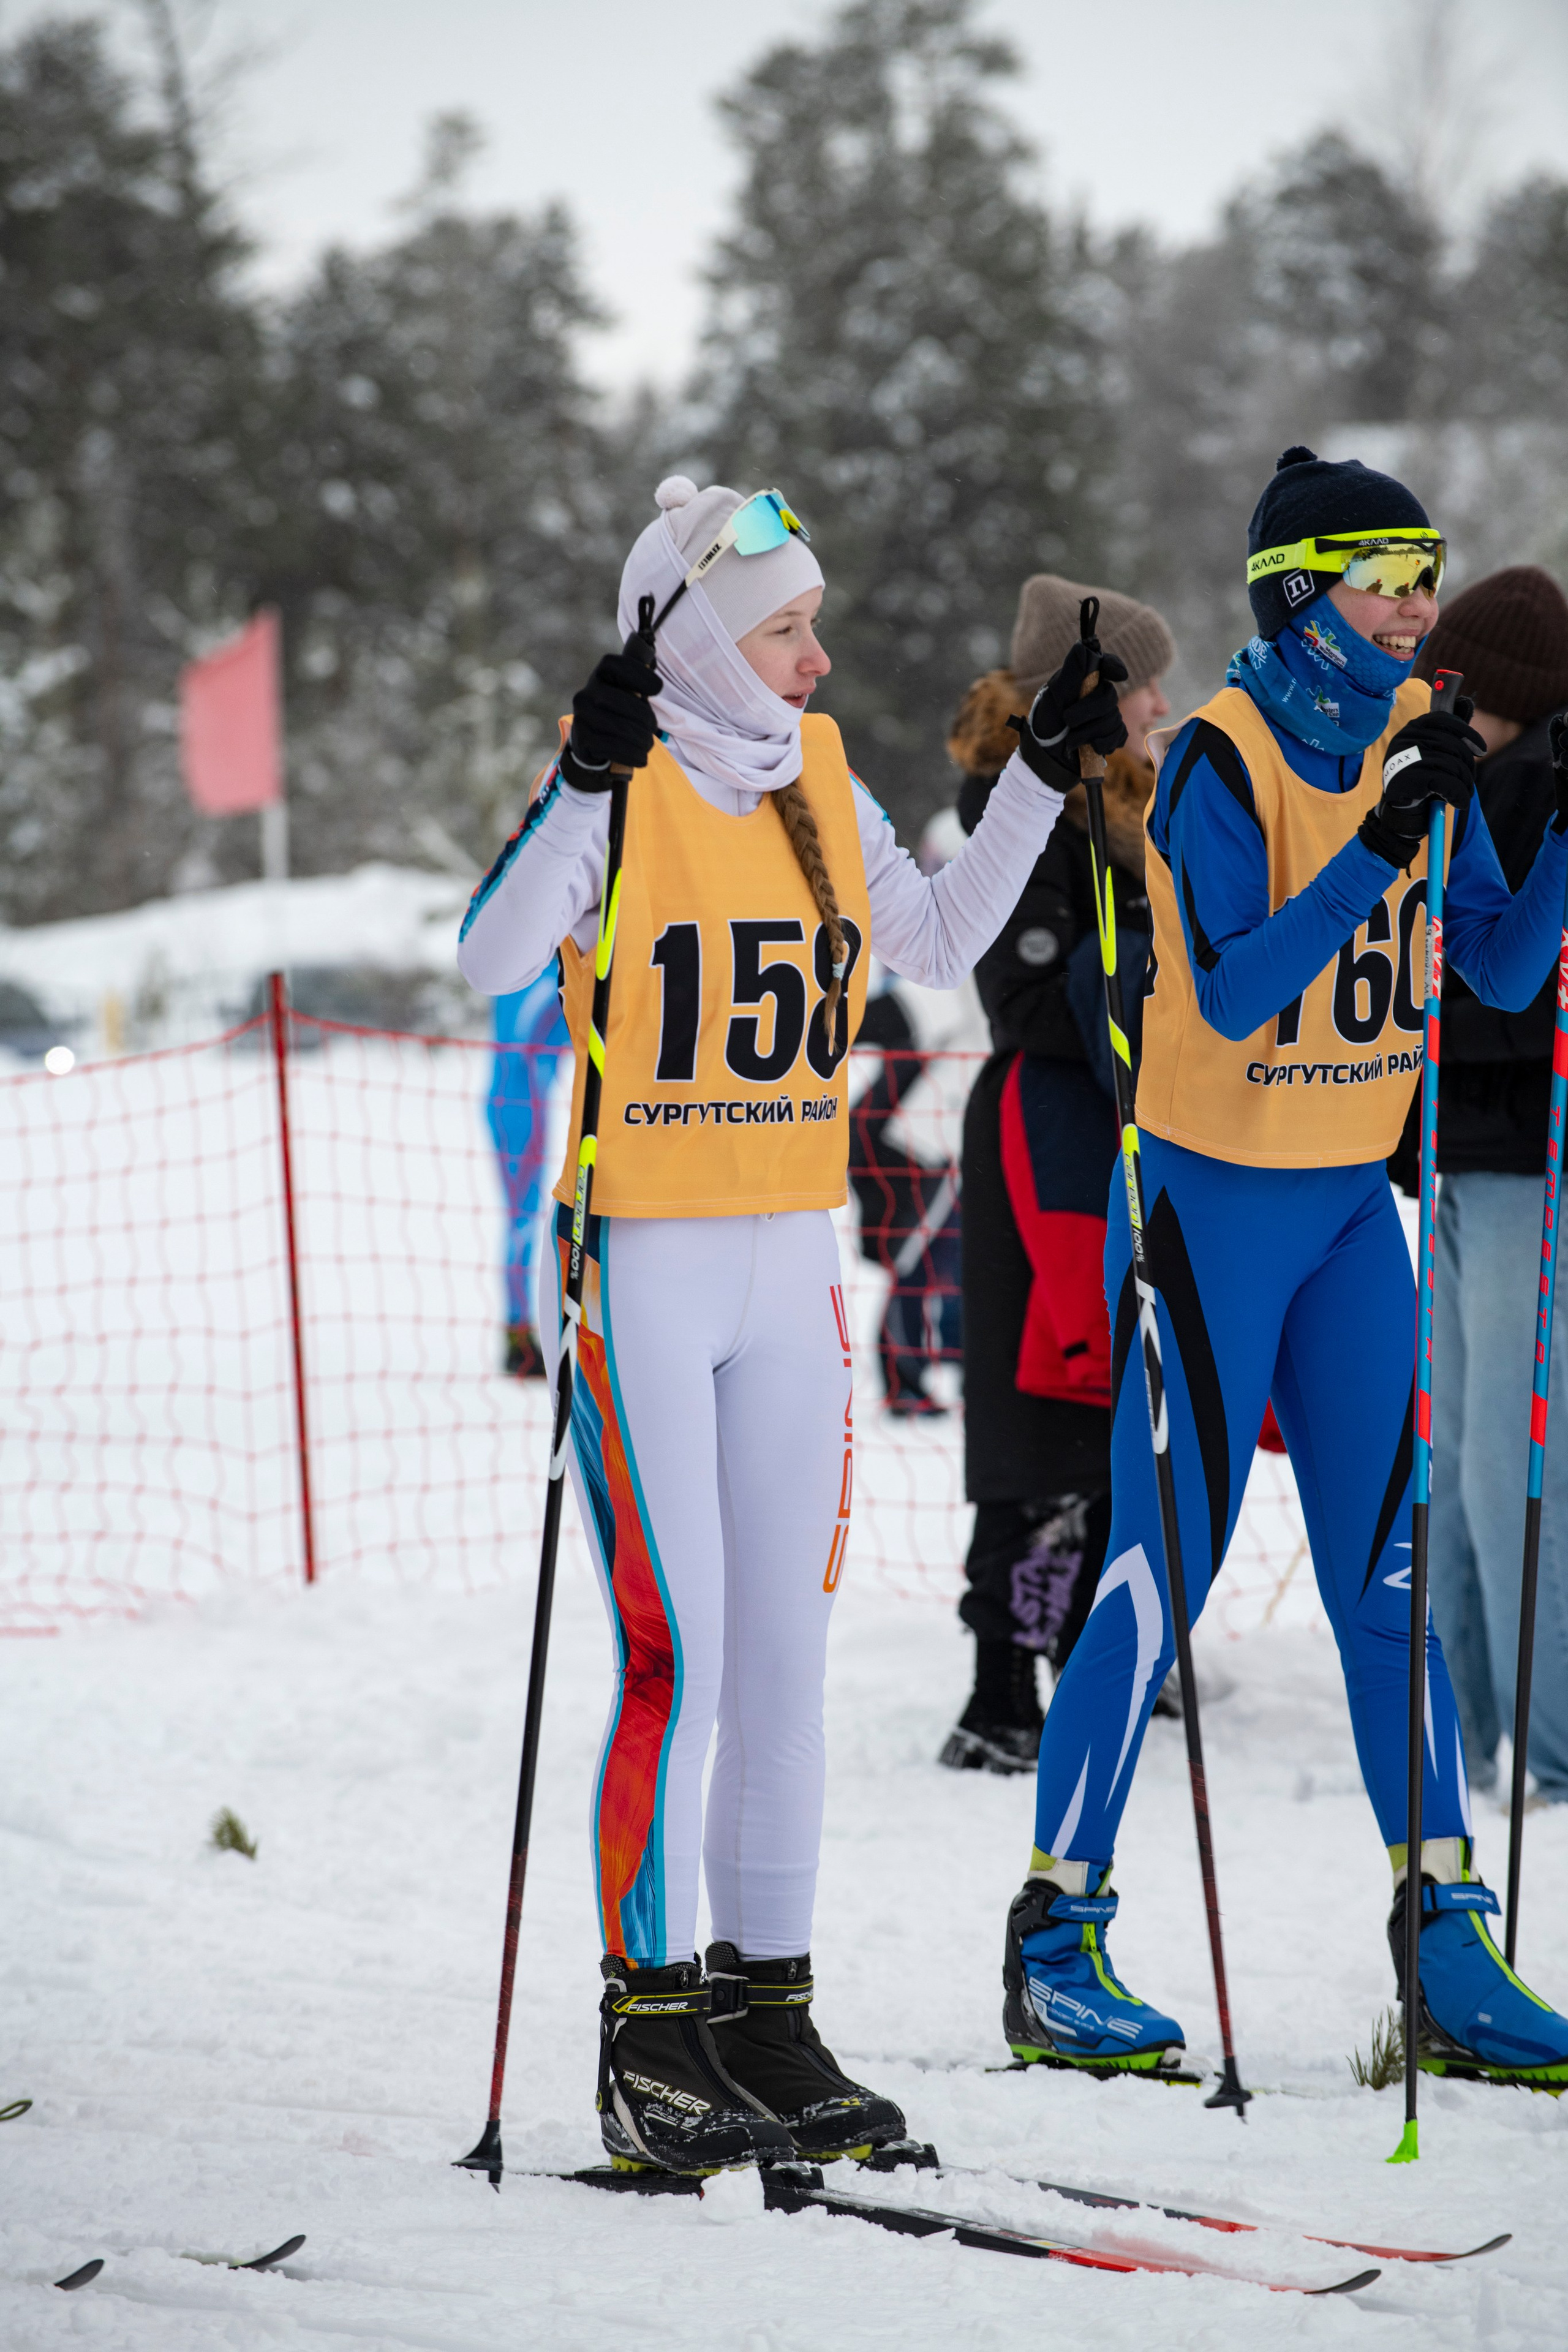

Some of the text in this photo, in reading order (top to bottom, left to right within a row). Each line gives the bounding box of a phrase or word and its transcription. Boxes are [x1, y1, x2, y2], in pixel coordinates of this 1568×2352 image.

[649, 916, 862, 1084] 158
[1245, 1044, 1424, 1087] СУРГУТСКИЙ РАЙ
[624, 1094, 839, 1126] СУРГУТСКИЙ РАЙОН
[570, 1242, 581, 1281] 100%
[1133, 1227, 1145, 1262] 100%
[1070, 1904, 1116, 1914] SPINE
[627, 2001, 688, 2012] FISCHER
[1028, 1975, 1144, 2040] SPINE
[622, 2069, 712, 2116] FISCHER
